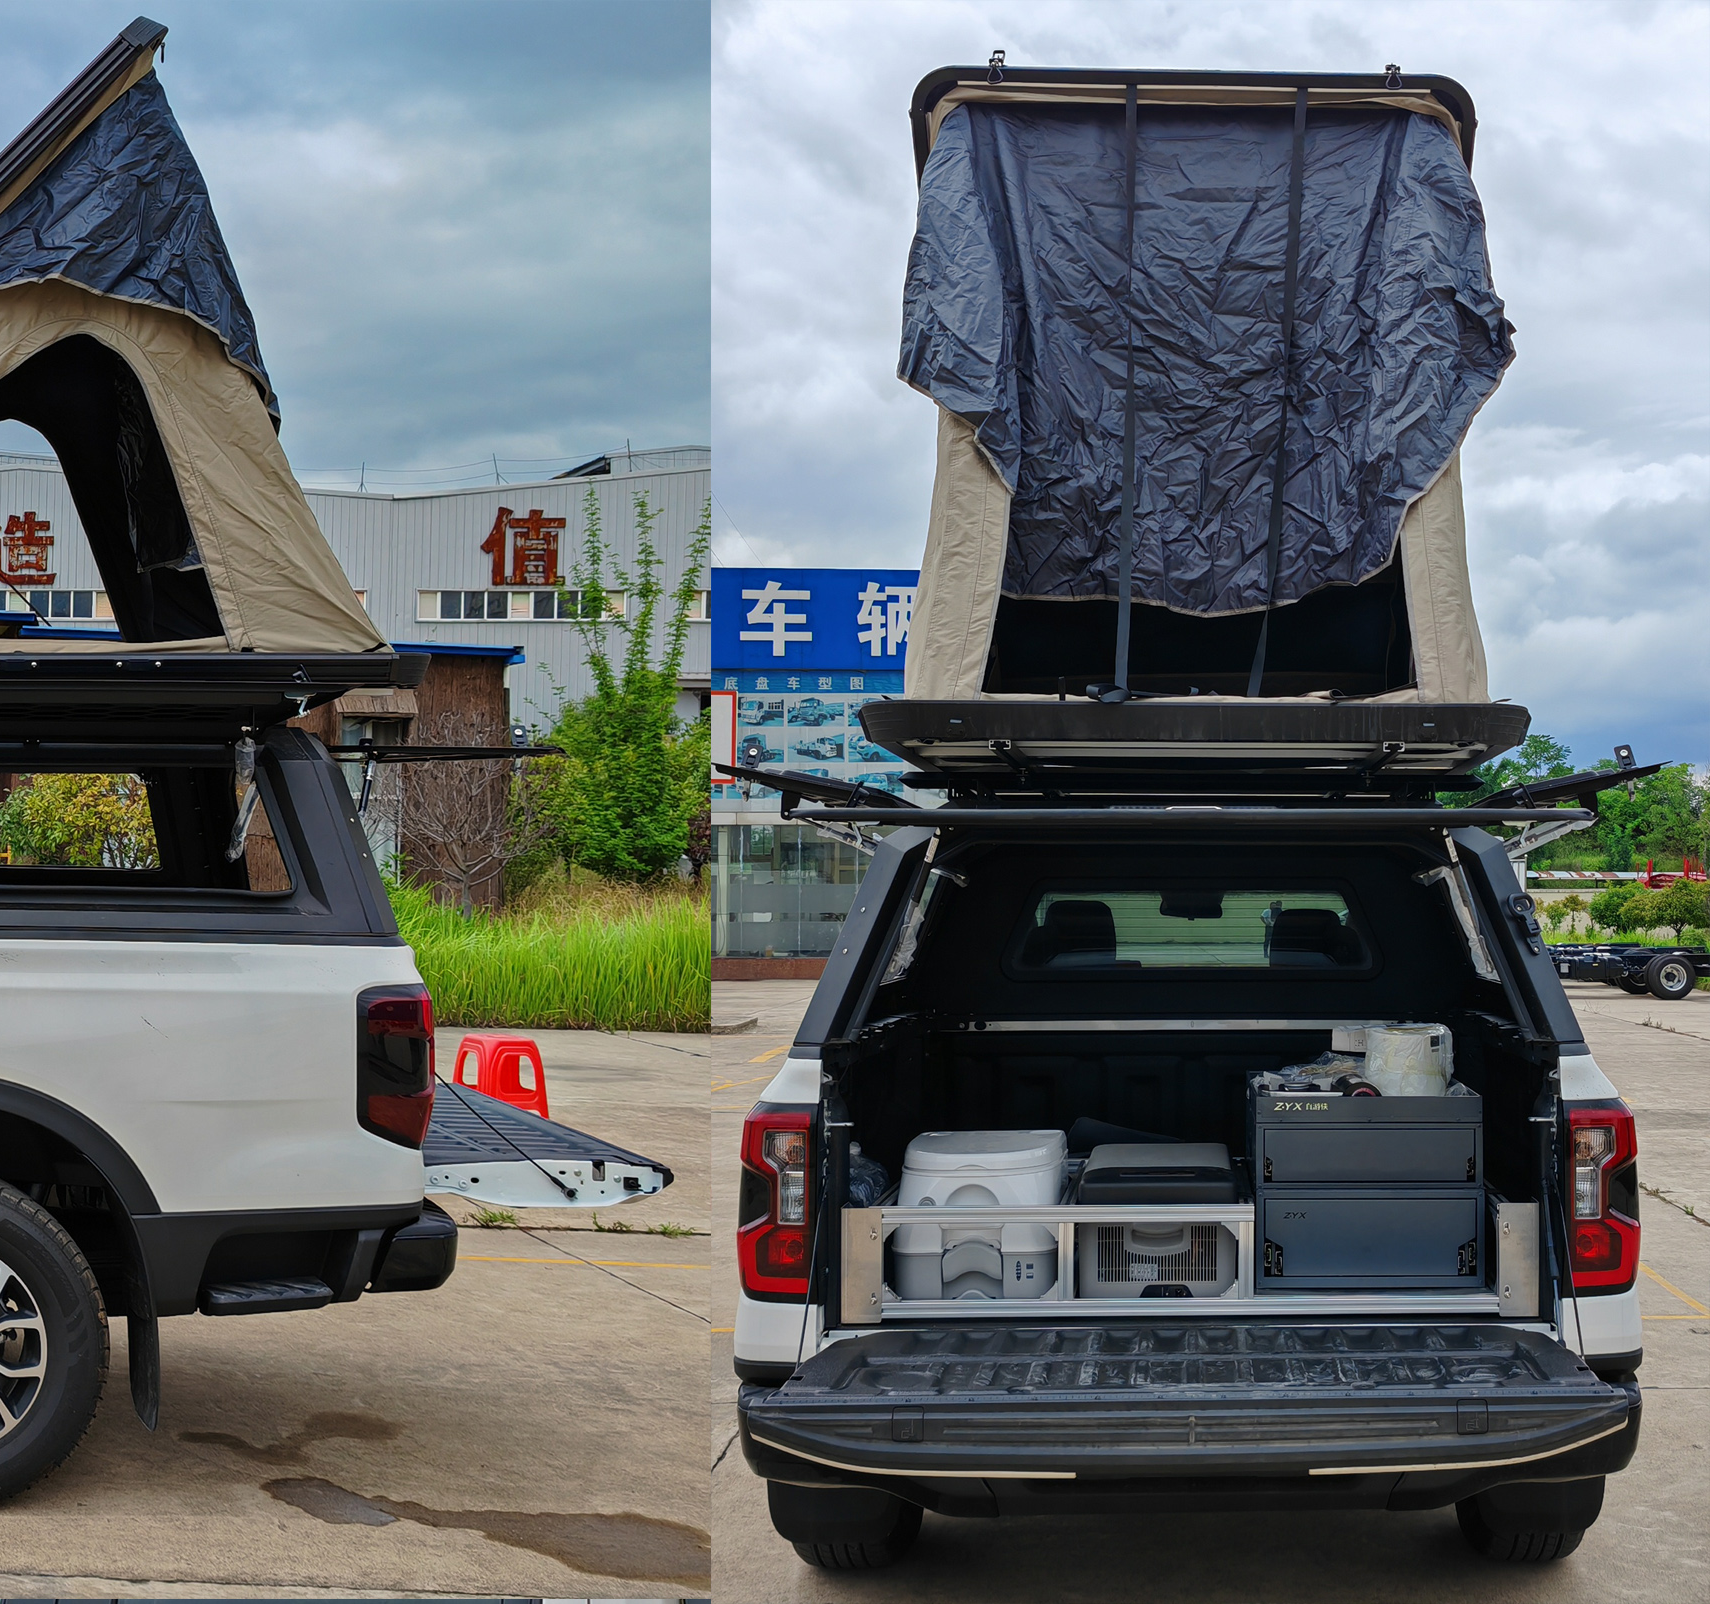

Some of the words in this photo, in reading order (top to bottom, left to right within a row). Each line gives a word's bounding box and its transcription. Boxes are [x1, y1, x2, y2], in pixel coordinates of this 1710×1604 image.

[481, 506, 566, 586] 值
[739, 580, 918, 657] 车辆
[723, 676, 864, 690] 底盘车型图
